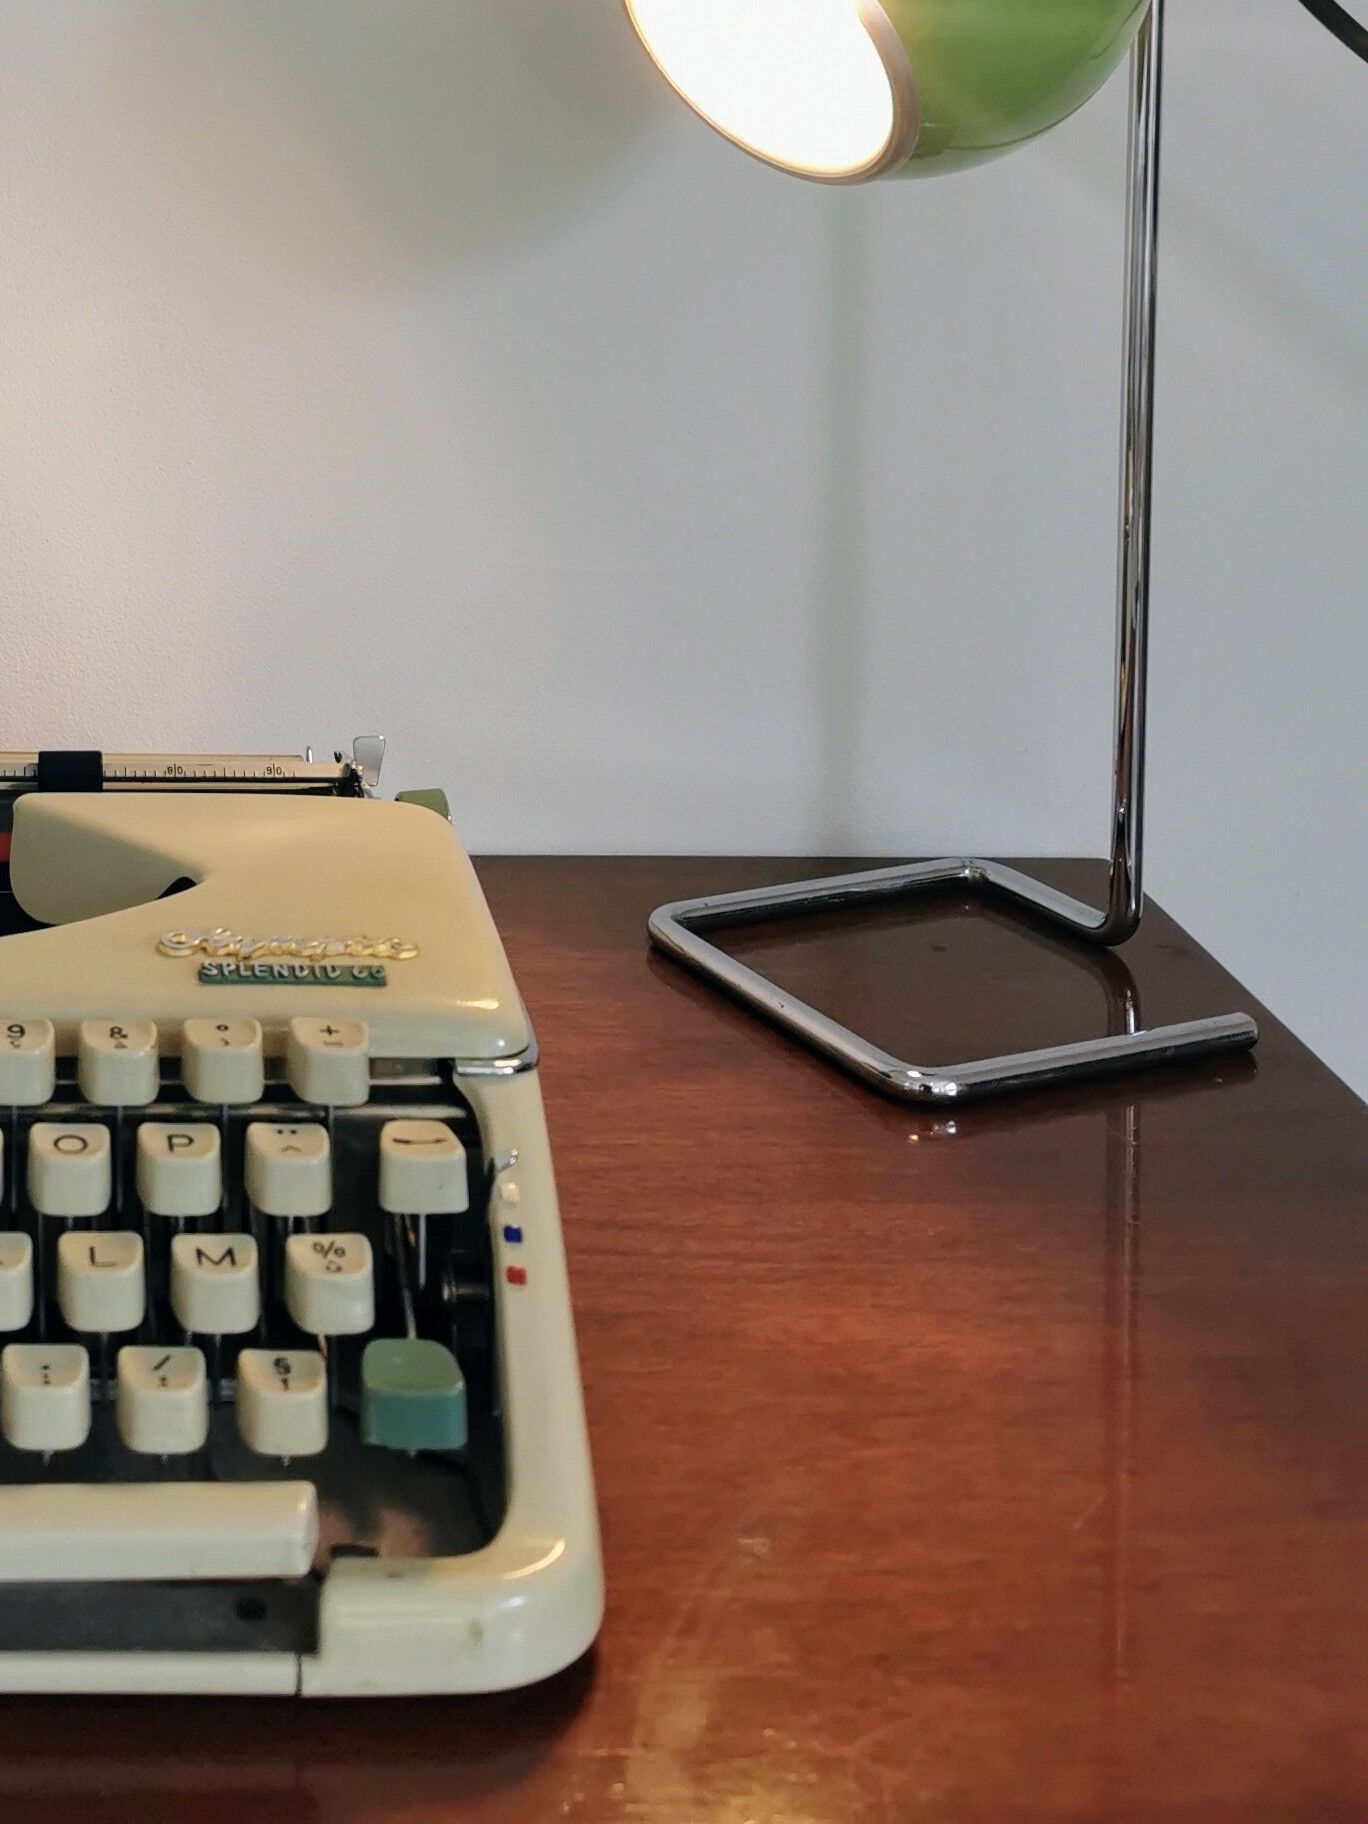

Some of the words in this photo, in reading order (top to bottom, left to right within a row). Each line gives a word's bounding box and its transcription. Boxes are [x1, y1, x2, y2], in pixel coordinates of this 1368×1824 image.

[6, 1023, 26, 1039] 9
[52, 1134, 89, 1155] O
[166, 1133, 195, 1154] P
[88, 1245, 116, 1268] L
[194, 1246, 237, 1268] M
